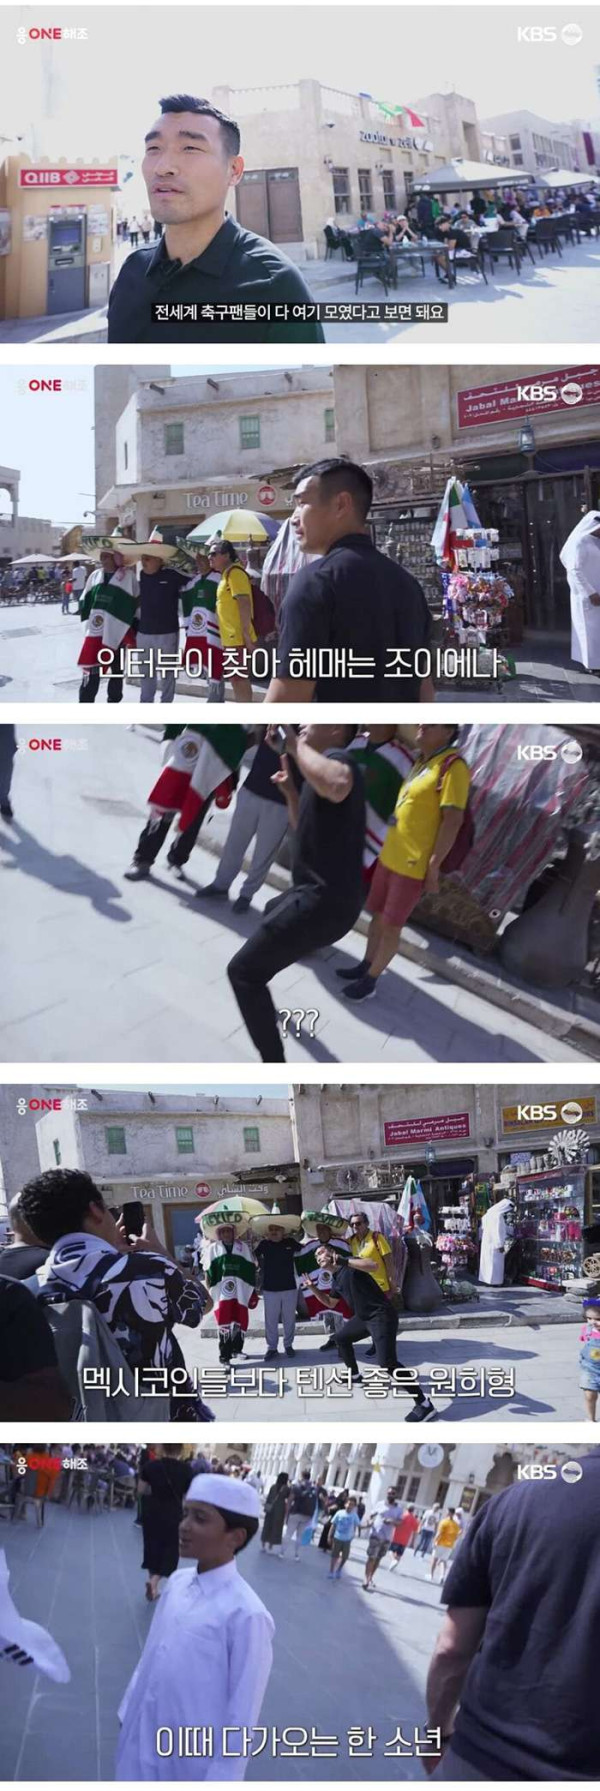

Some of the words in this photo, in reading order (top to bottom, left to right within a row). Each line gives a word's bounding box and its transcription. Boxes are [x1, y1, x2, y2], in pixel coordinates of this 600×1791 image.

[24, 172, 60, 183] QIIB
[465, 399, 497, 413] Jabal
[182, 492, 210, 508] Tea
[213, 490, 248, 507] Time
[390, 1129, 409, 1137] Jabal
[131, 1186, 155, 1198] Tea
[156, 1184, 188, 1198] Time
